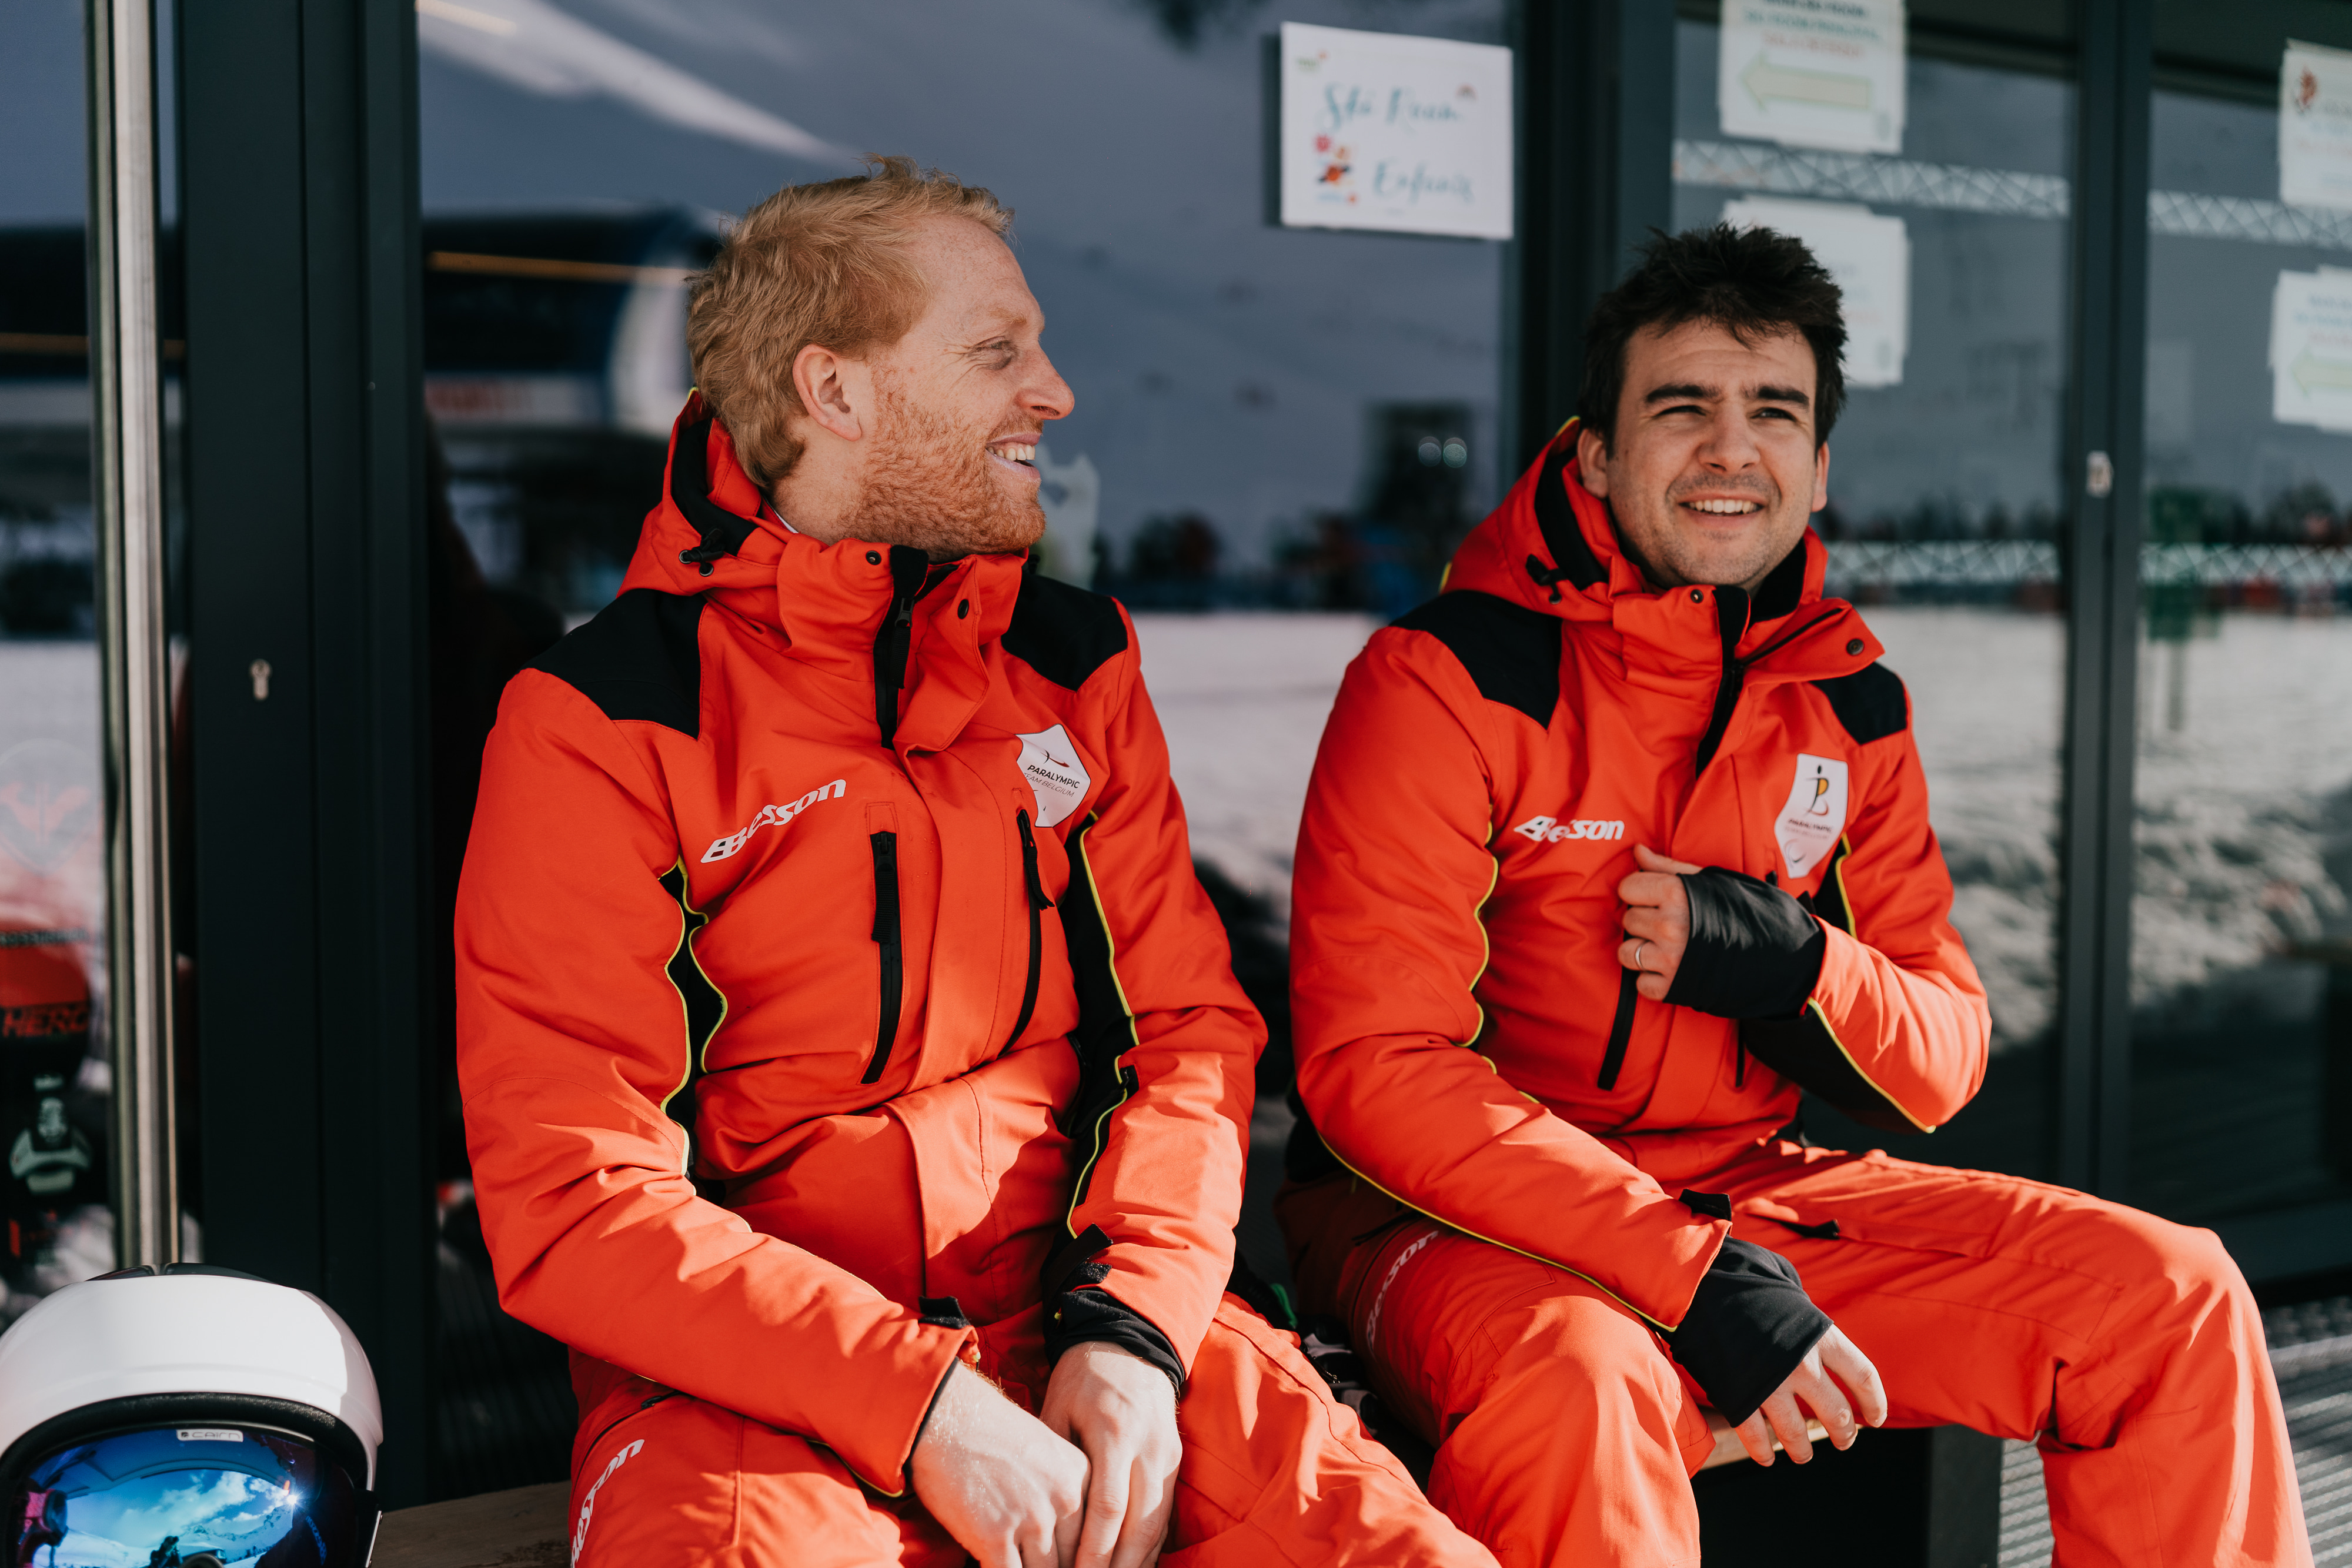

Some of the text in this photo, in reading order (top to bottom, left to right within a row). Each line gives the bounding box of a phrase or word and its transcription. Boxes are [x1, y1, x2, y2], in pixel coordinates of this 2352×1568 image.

[1024, 773, 1075, 798] TEAM BELGIUM
[1027, 764, 1081, 789] PARALYMPIC
[700, 779, 847, 864] Besson
[1514, 815, 1625, 843] Beson
